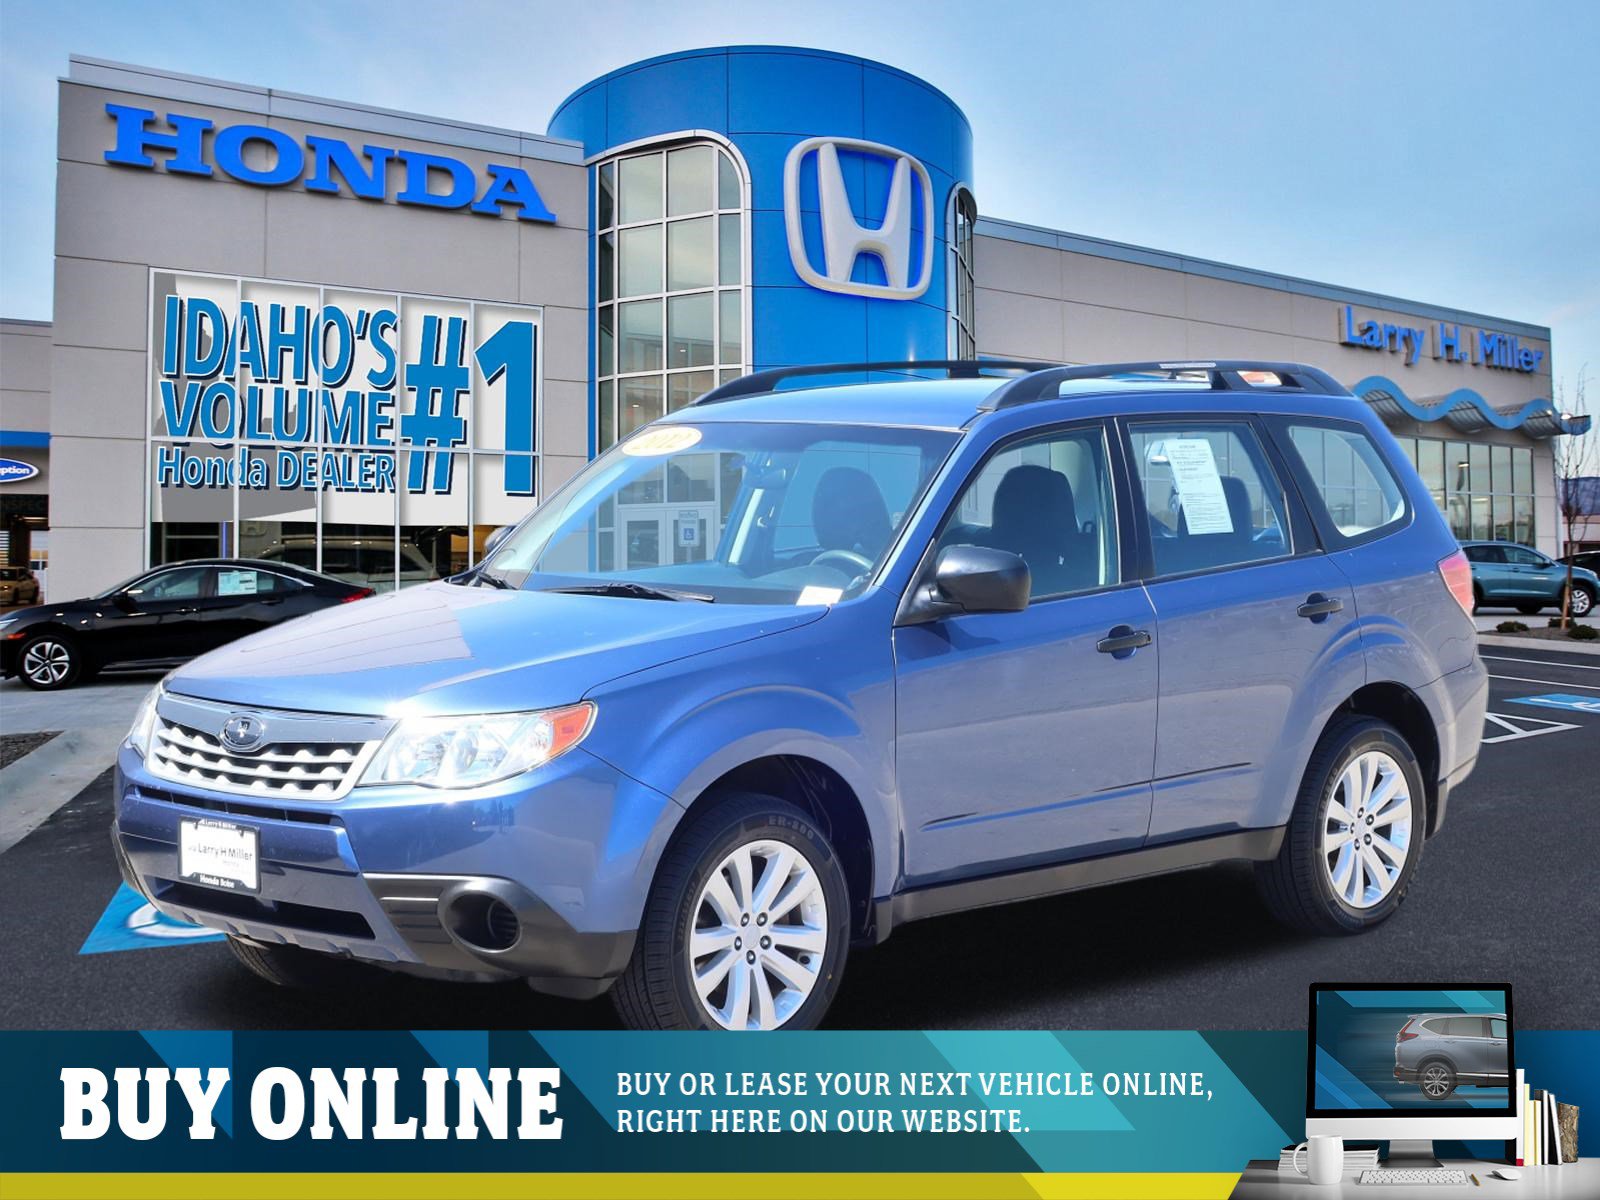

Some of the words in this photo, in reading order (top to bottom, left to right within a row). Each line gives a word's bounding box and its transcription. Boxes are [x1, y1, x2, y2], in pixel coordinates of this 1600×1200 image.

[105, 103, 557, 224] HONDA
[161, 294, 399, 389] IDAHO'S
[1339, 304, 1425, 366] Larry
[1433, 322, 1468, 362] H.
[1472, 329, 1545, 373] Miller
[159, 380, 398, 449] VOLUME
[400, 314, 538, 496] #1
[0, 466, 30, 475] ption
[157, 446, 269, 490] Honda
[275, 448, 397, 493] DEALER
[198, 843, 219, 859] Larry
[220, 846, 227, 858] H
[228, 847, 253, 861] Miller
